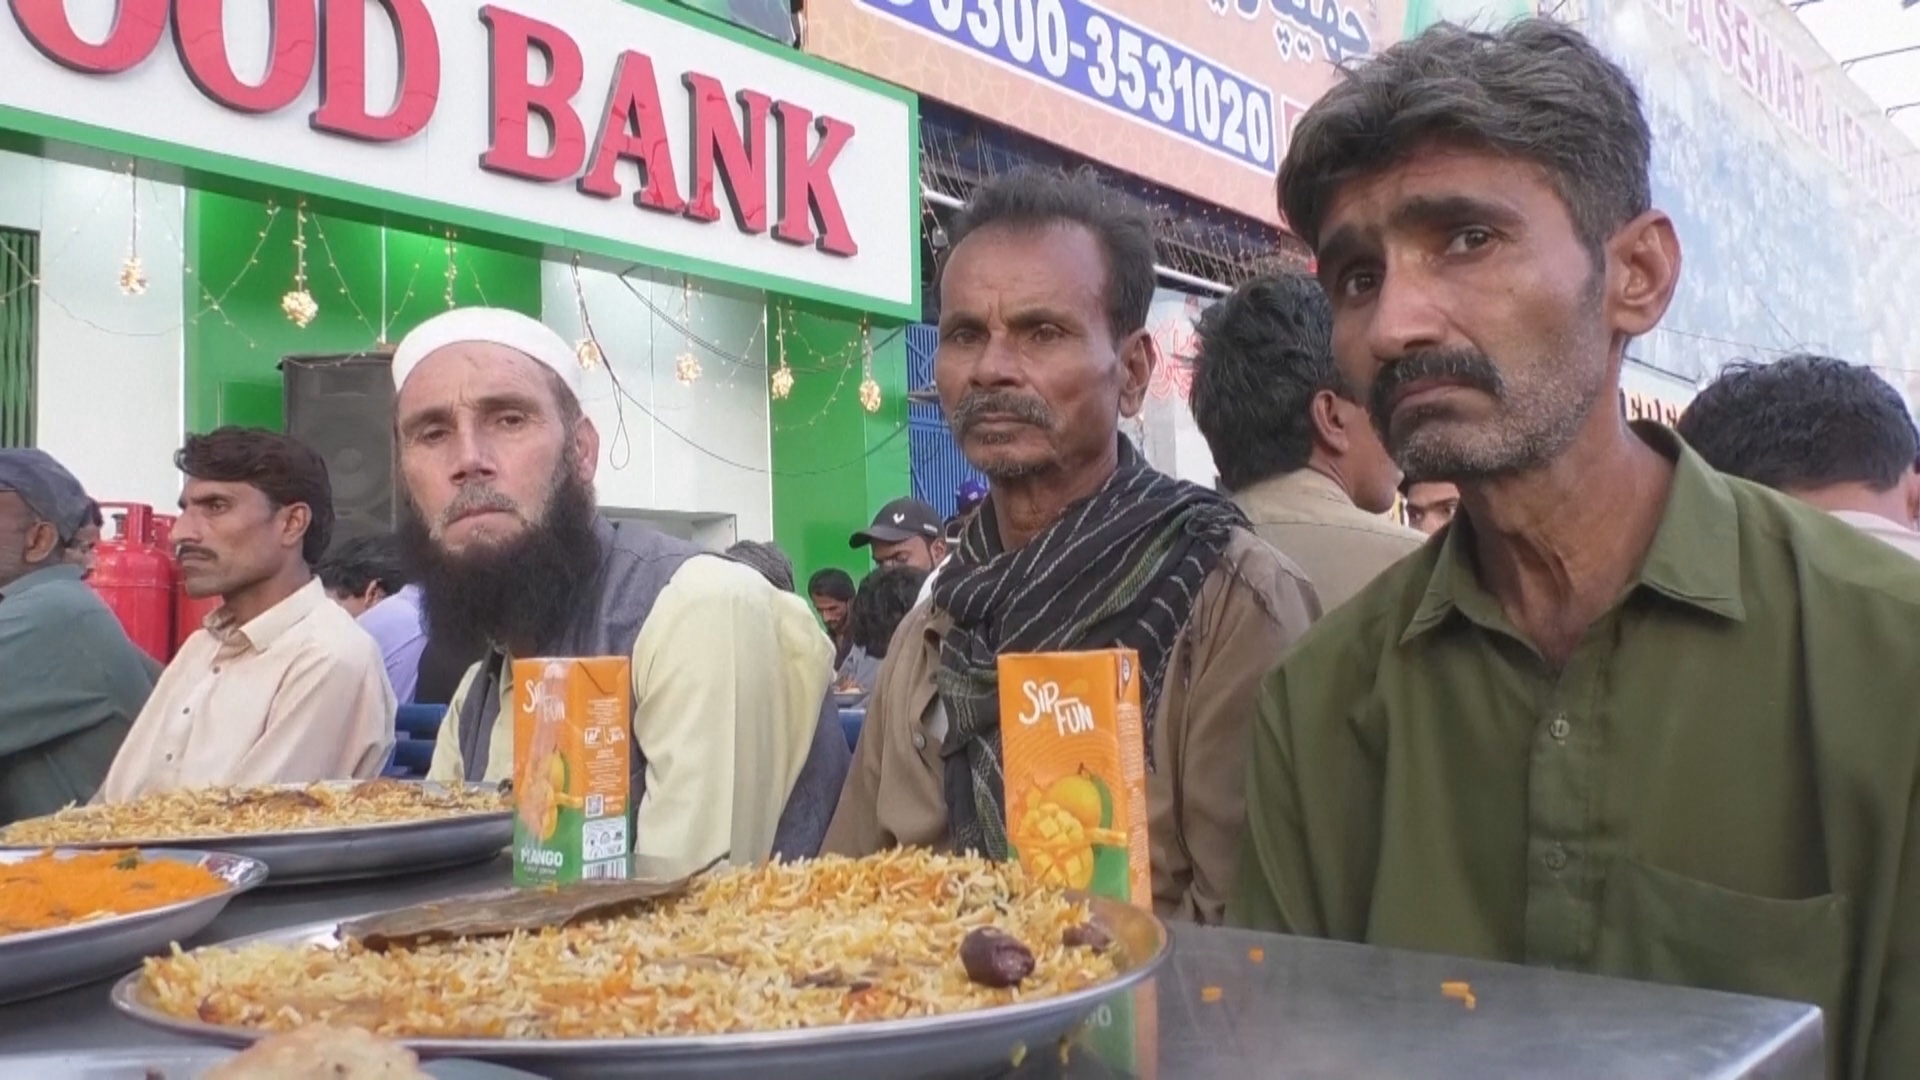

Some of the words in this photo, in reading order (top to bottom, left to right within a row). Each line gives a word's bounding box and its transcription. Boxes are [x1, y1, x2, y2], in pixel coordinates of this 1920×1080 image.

[1714, 0, 1809, 136] SEHAR
[479, 4, 859, 259] BANK
[1018, 679, 1060, 726] SIP
[1054, 697, 1095, 737] FUN
[520, 847, 564, 869] MANGO
